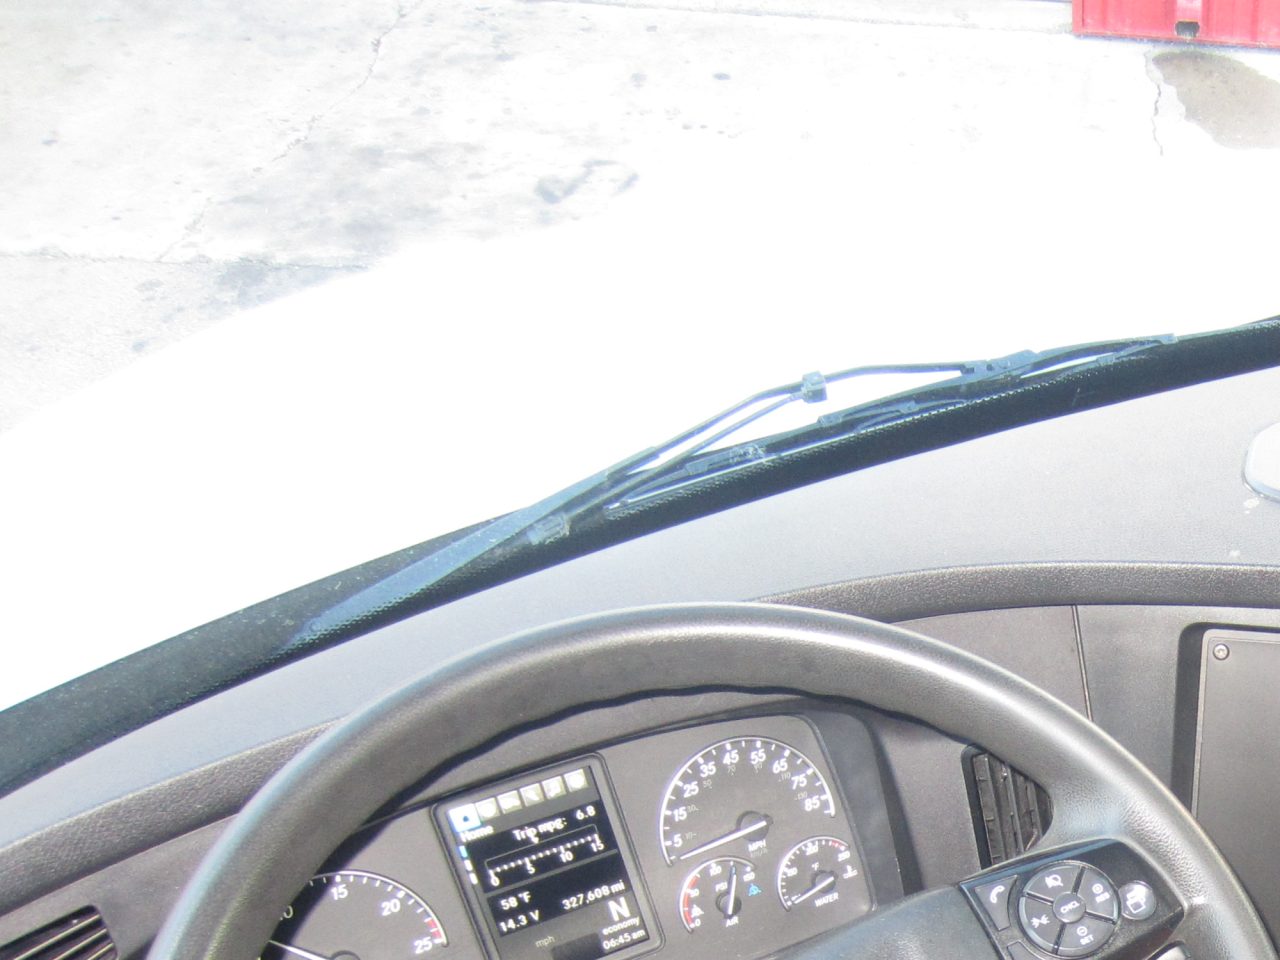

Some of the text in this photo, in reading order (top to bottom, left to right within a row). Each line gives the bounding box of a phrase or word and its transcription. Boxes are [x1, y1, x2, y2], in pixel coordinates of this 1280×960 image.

[723, 750, 739, 765] 45
[750, 750, 766, 765] 55
[700, 764, 717, 778] 35
[772, 760, 788, 774] 65
[683, 782, 699, 798] 25
[791, 775, 807, 790] 75
[804, 797, 820, 812] 85
[673, 807, 687, 822] 15
[513, 805, 597, 843] Trip mpg: 6.8
[591, 841, 605, 852] 15
[673, 836, 682, 848] 5
[748, 840, 767, 852] MPH
[559, 852, 574, 863] 10
[527, 864, 536, 874] 5
[331, 885, 348, 900] 15
[715, 882, 728, 892] PSI
[562, 879, 626, 911] 327,608 mi
[815, 893, 839, 907] WATER
[381, 900, 400, 915] 20
[500, 897, 518, 911] 58
[608, 896, 631, 922] N
[499, 910, 540, 933] 14.3 V
[602, 916, 640, 935] economy
[726, 917, 739, 927] AIR
[414, 938, 432, 953] 25
[535, 936, 555, 949] mph
[602, 929, 646, 950] 06:45 am
